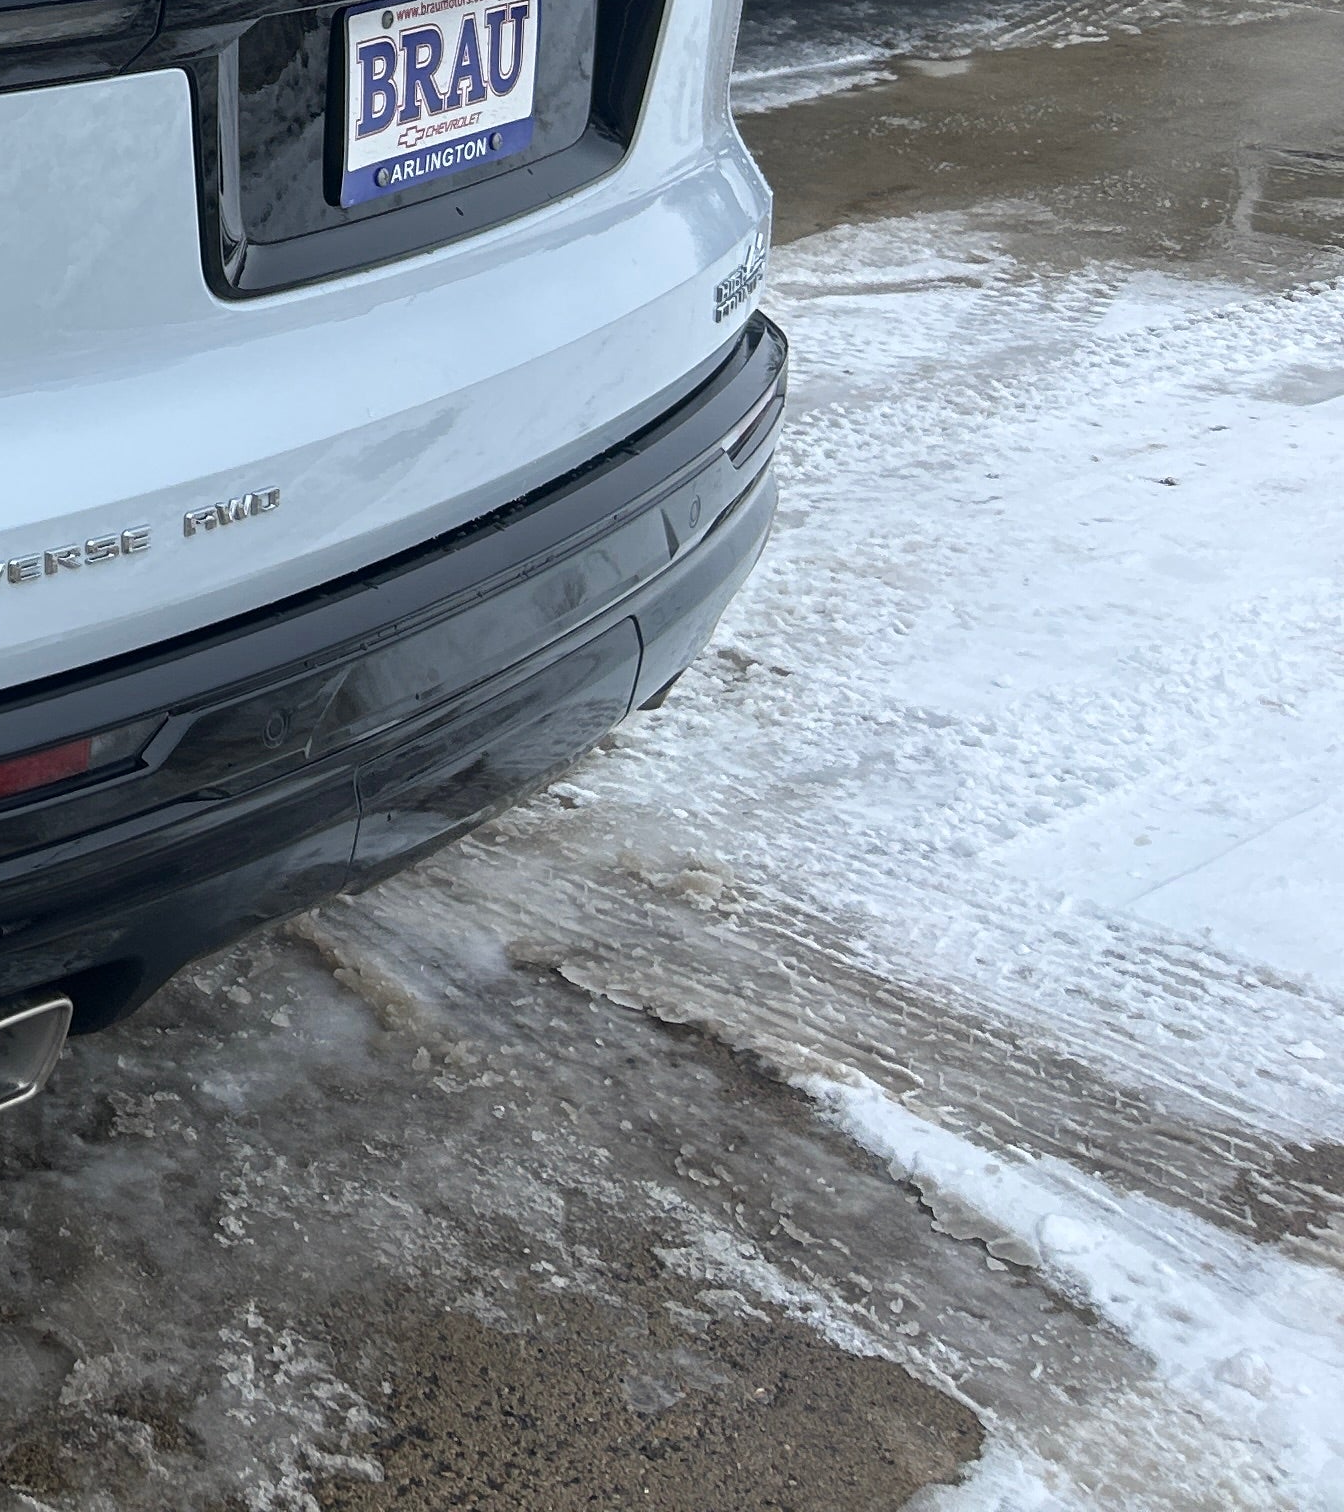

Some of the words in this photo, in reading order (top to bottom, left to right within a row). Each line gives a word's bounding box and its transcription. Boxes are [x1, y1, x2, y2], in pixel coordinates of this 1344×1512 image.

[425, 111, 484, 137] CHEVROLET
[390, 137, 487, 184] ARLINGTON
[183, 485, 280, 537] AWD
